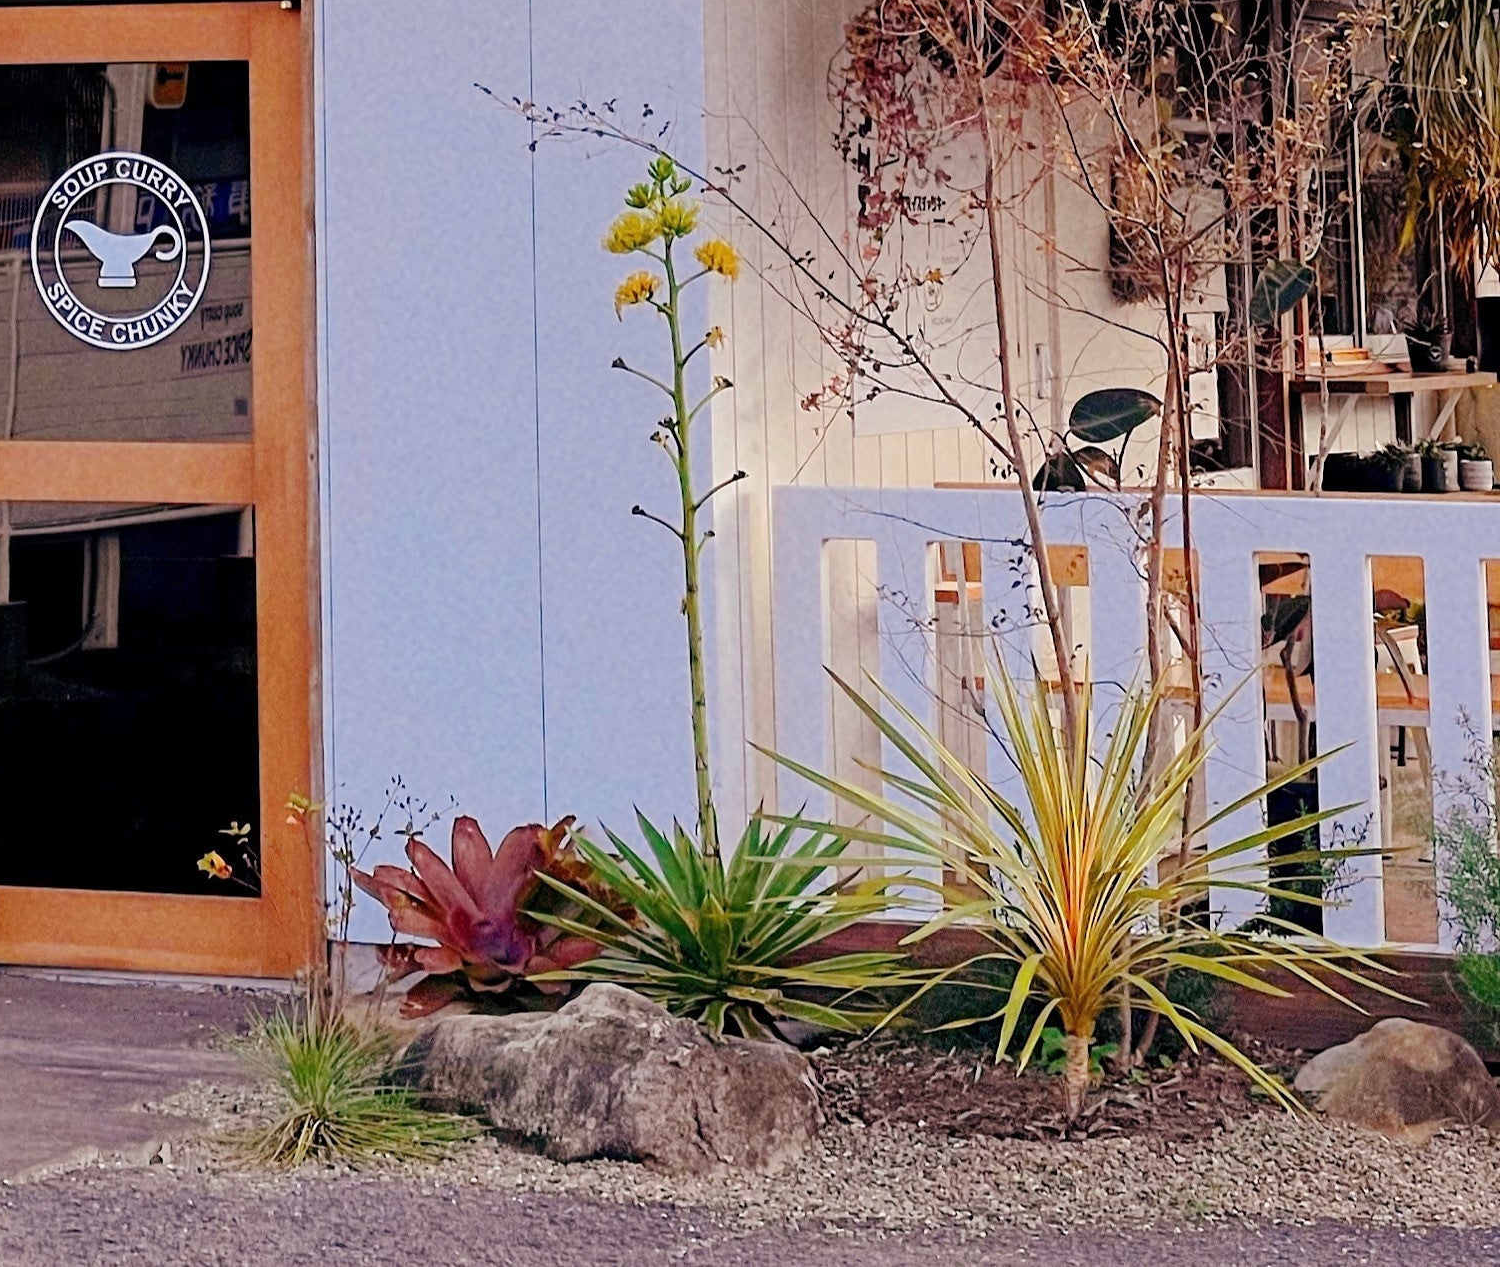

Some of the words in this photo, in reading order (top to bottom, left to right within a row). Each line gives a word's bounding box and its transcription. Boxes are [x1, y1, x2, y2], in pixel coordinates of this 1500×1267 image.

[52, 161, 108, 210] SOUP
[115, 159, 191, 209] CURRY
[47, 281, 105, 342] SPICE
[111, 281, 195, 344] CHUNKY
